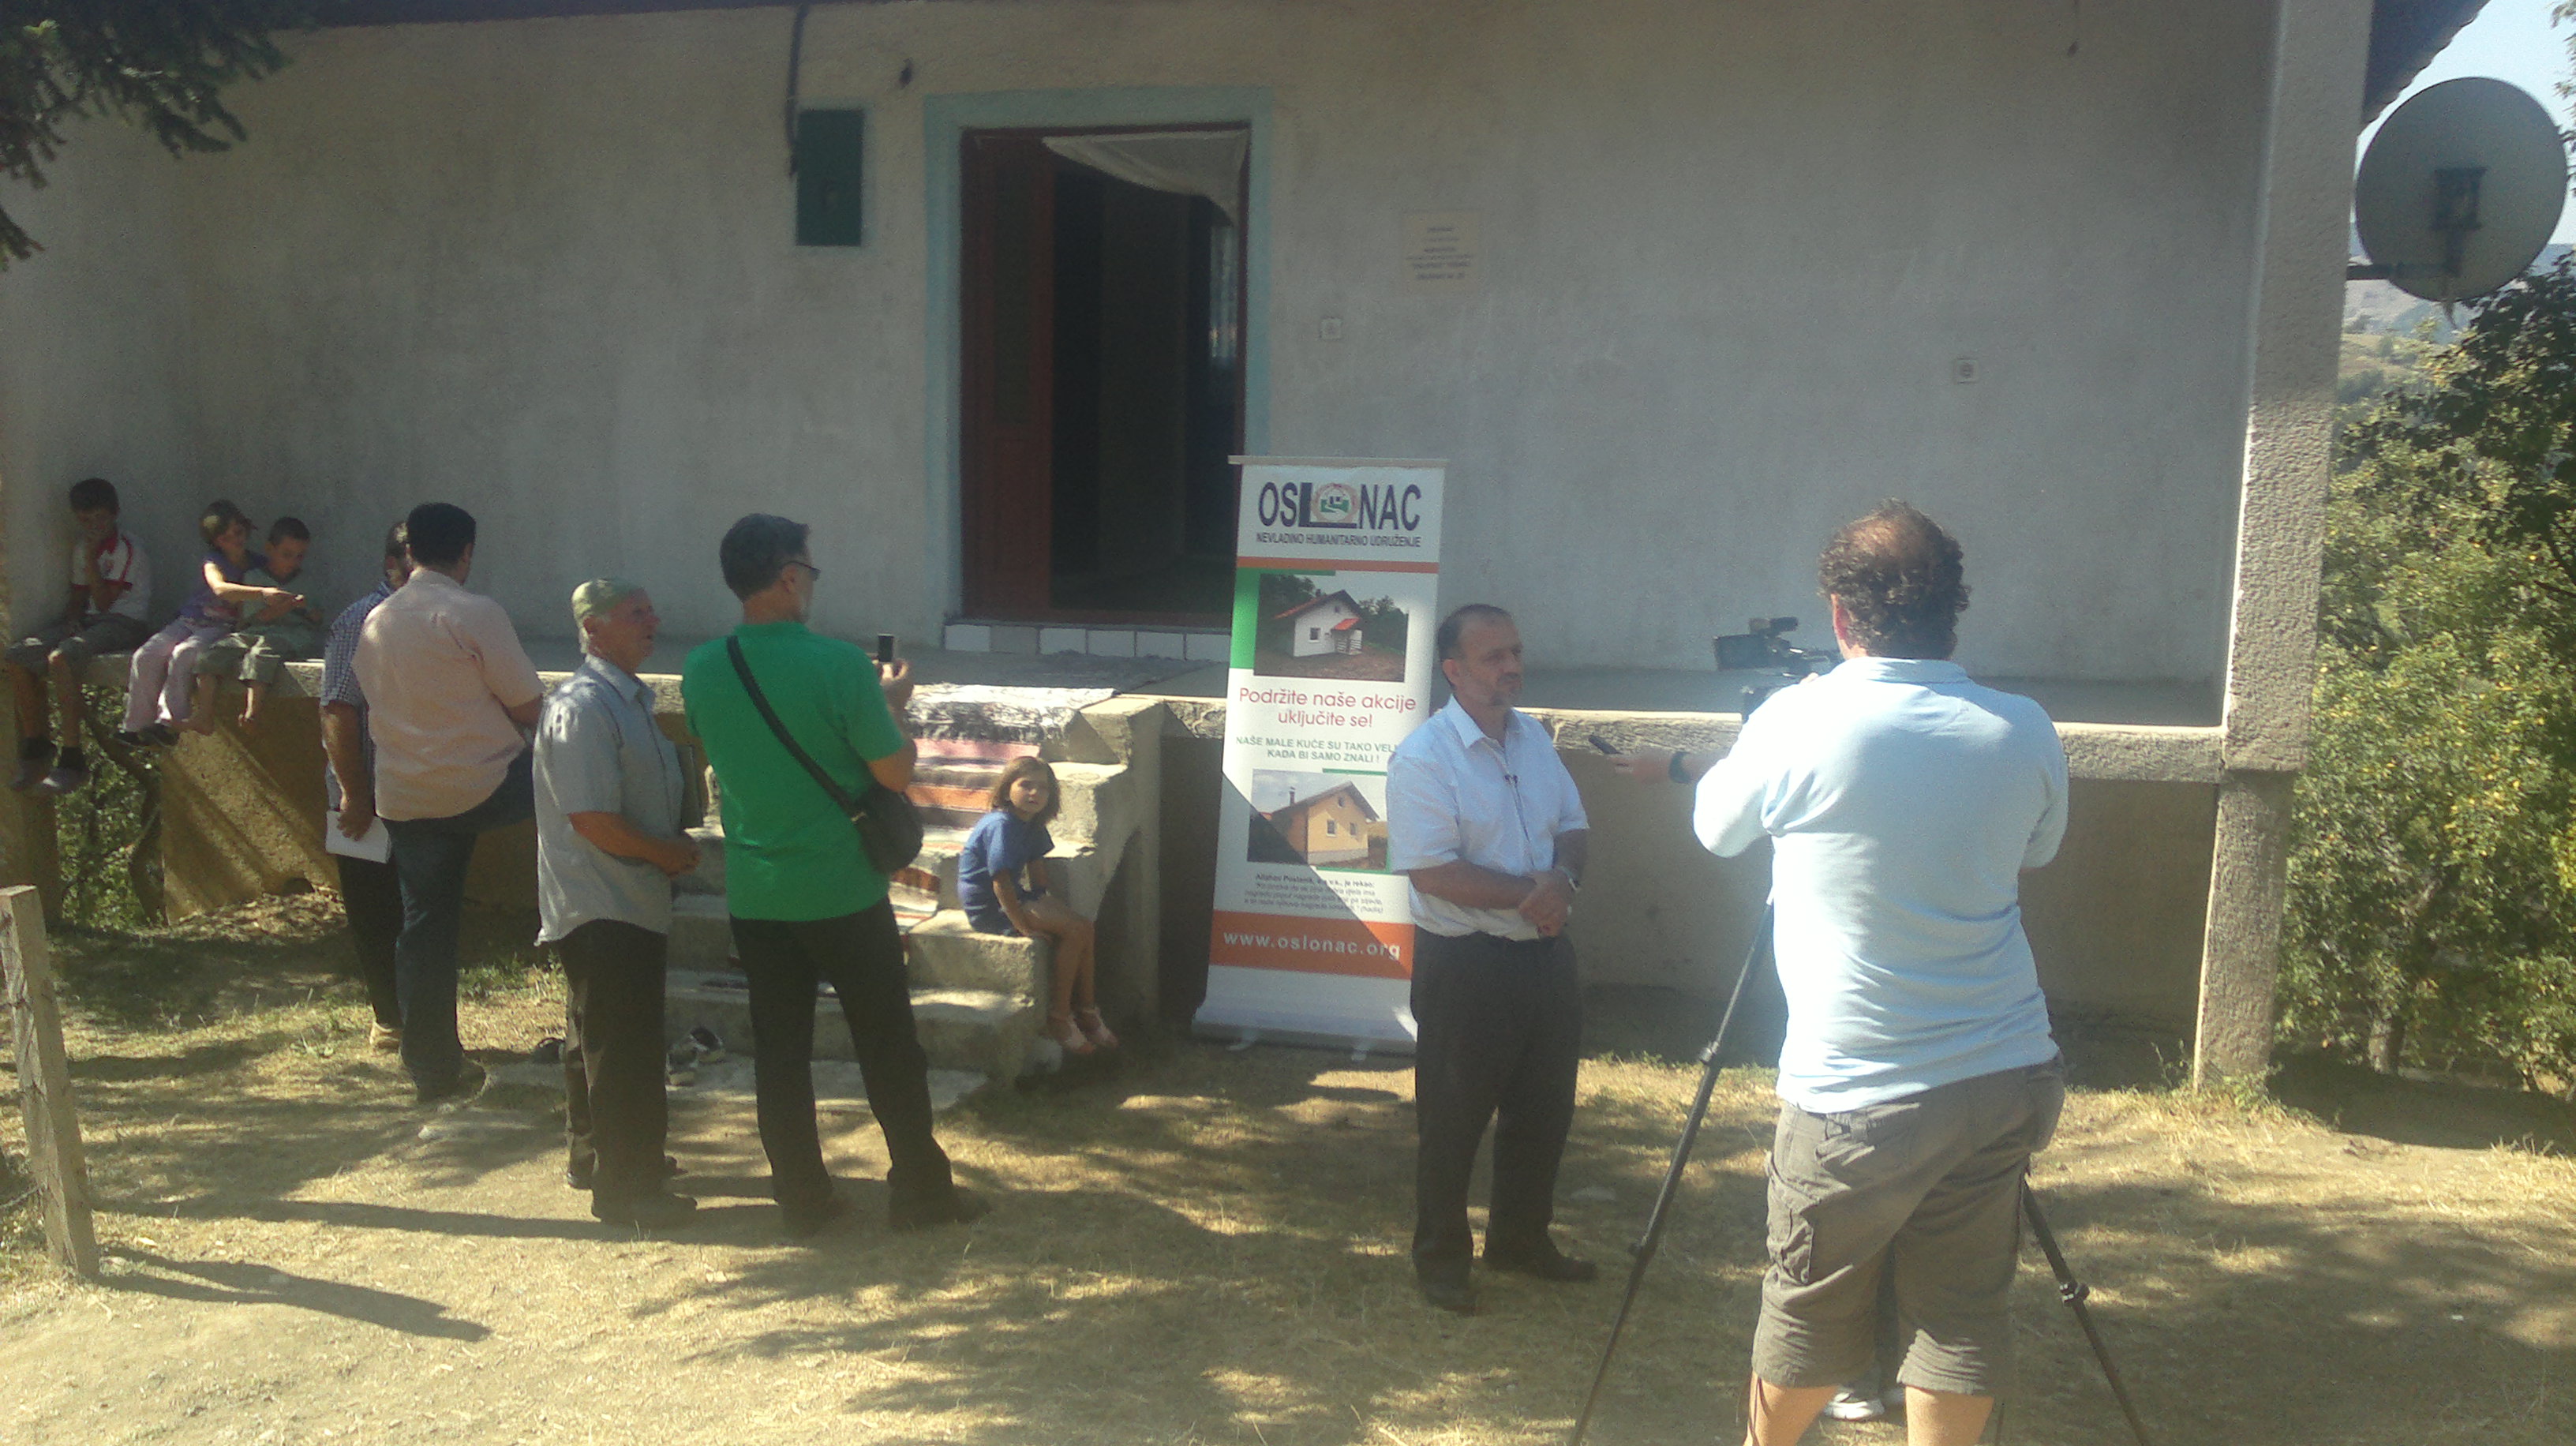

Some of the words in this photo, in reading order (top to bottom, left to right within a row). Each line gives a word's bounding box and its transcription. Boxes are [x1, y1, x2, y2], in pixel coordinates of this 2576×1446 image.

[1256, 532, 1305, 545] NEVLADINO
[1306, 534, 1368, 546] HUMANITARNO
[1369, 534, 1421, 548] UDRUŽENJE
[1239, 687, 1308, 705] Podržite
[1313, 691, 1356, 707] naše
[1361, 694, 1417, 714] akcije
[1278, 710, 1346, 727] uključite
[1350, 714, 1372, 728] se!
[1236, 735, 1263, 746] NAŠE
[1265, 737, 1294, 747] MALE
[1327, 740, 1342, 750] SU
[1343, 741, 1372, 751] TAKO
[1267, 749, 1296, 759] KADA
[1298, 751, 1309, 760] BI
[1311, 751, 1342, 761] SAMO
[1343, 753, 1374, 762] ZNALI
[1223, 931, 1400, 960] www.oslonac.org
